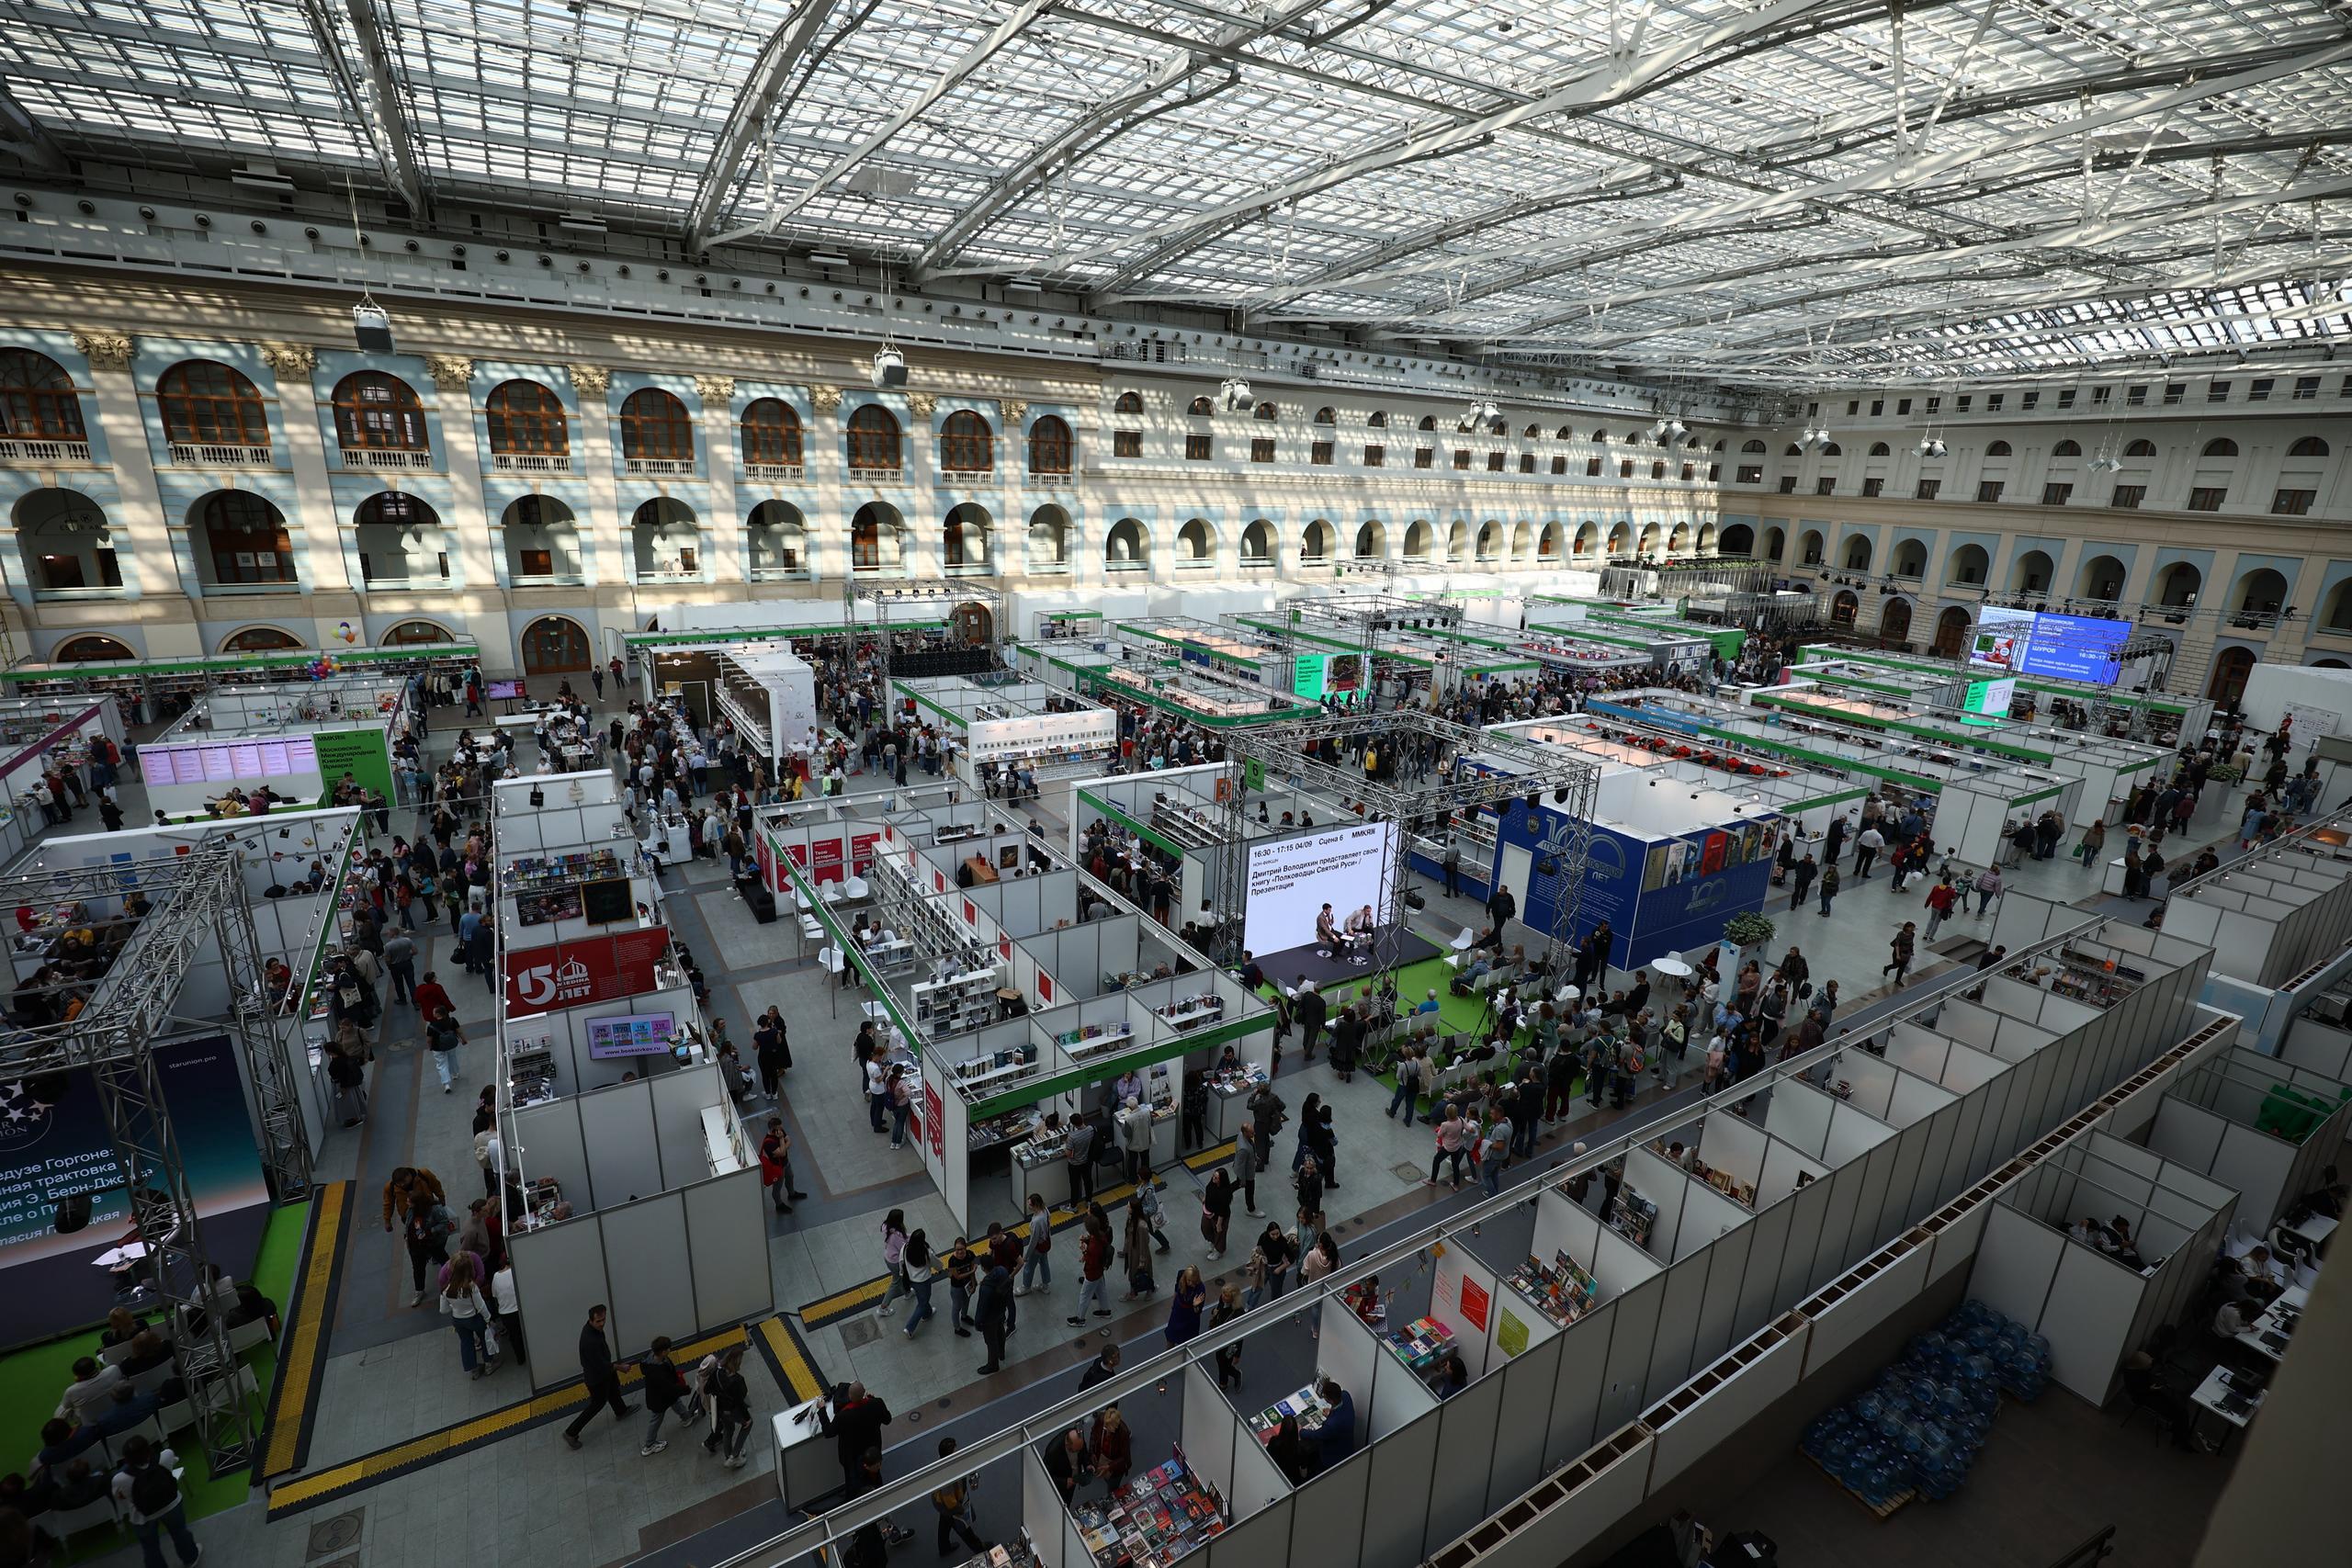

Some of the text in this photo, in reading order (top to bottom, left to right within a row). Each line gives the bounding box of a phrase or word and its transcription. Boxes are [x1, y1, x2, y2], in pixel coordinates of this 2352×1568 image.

[1252, 764, 1259, 776] 6
[1254, 849, 1272, 858] 16:30
[1277, 844, 1294, 853] 17:15
[1295, 840, 1313, 850] 04/09
[1318, 838, 1339, 846] Сцена
[1251, 848, 1379, 879] Дмитрий Володихин представляет свою
[1251, 877, 1271, 887] книгу
[1271, 869, 1315, 883] «Полководцы
[1317, 863, 1340, 874] Святой
[1250, 882, 1295, 896] Презентация
[517, 963, 557, 1006] 15
[558, 985, 591, 1000] ЛЕТ
[169, 1055, 217, 1069] starunion.pro
[45, 1148, 114, 1170] Горгоне:
[35, 1162, 117, 1187] трактовка
[25, 1193, 44, 1204] Э.
[27, 1211, 38, 1219] о
